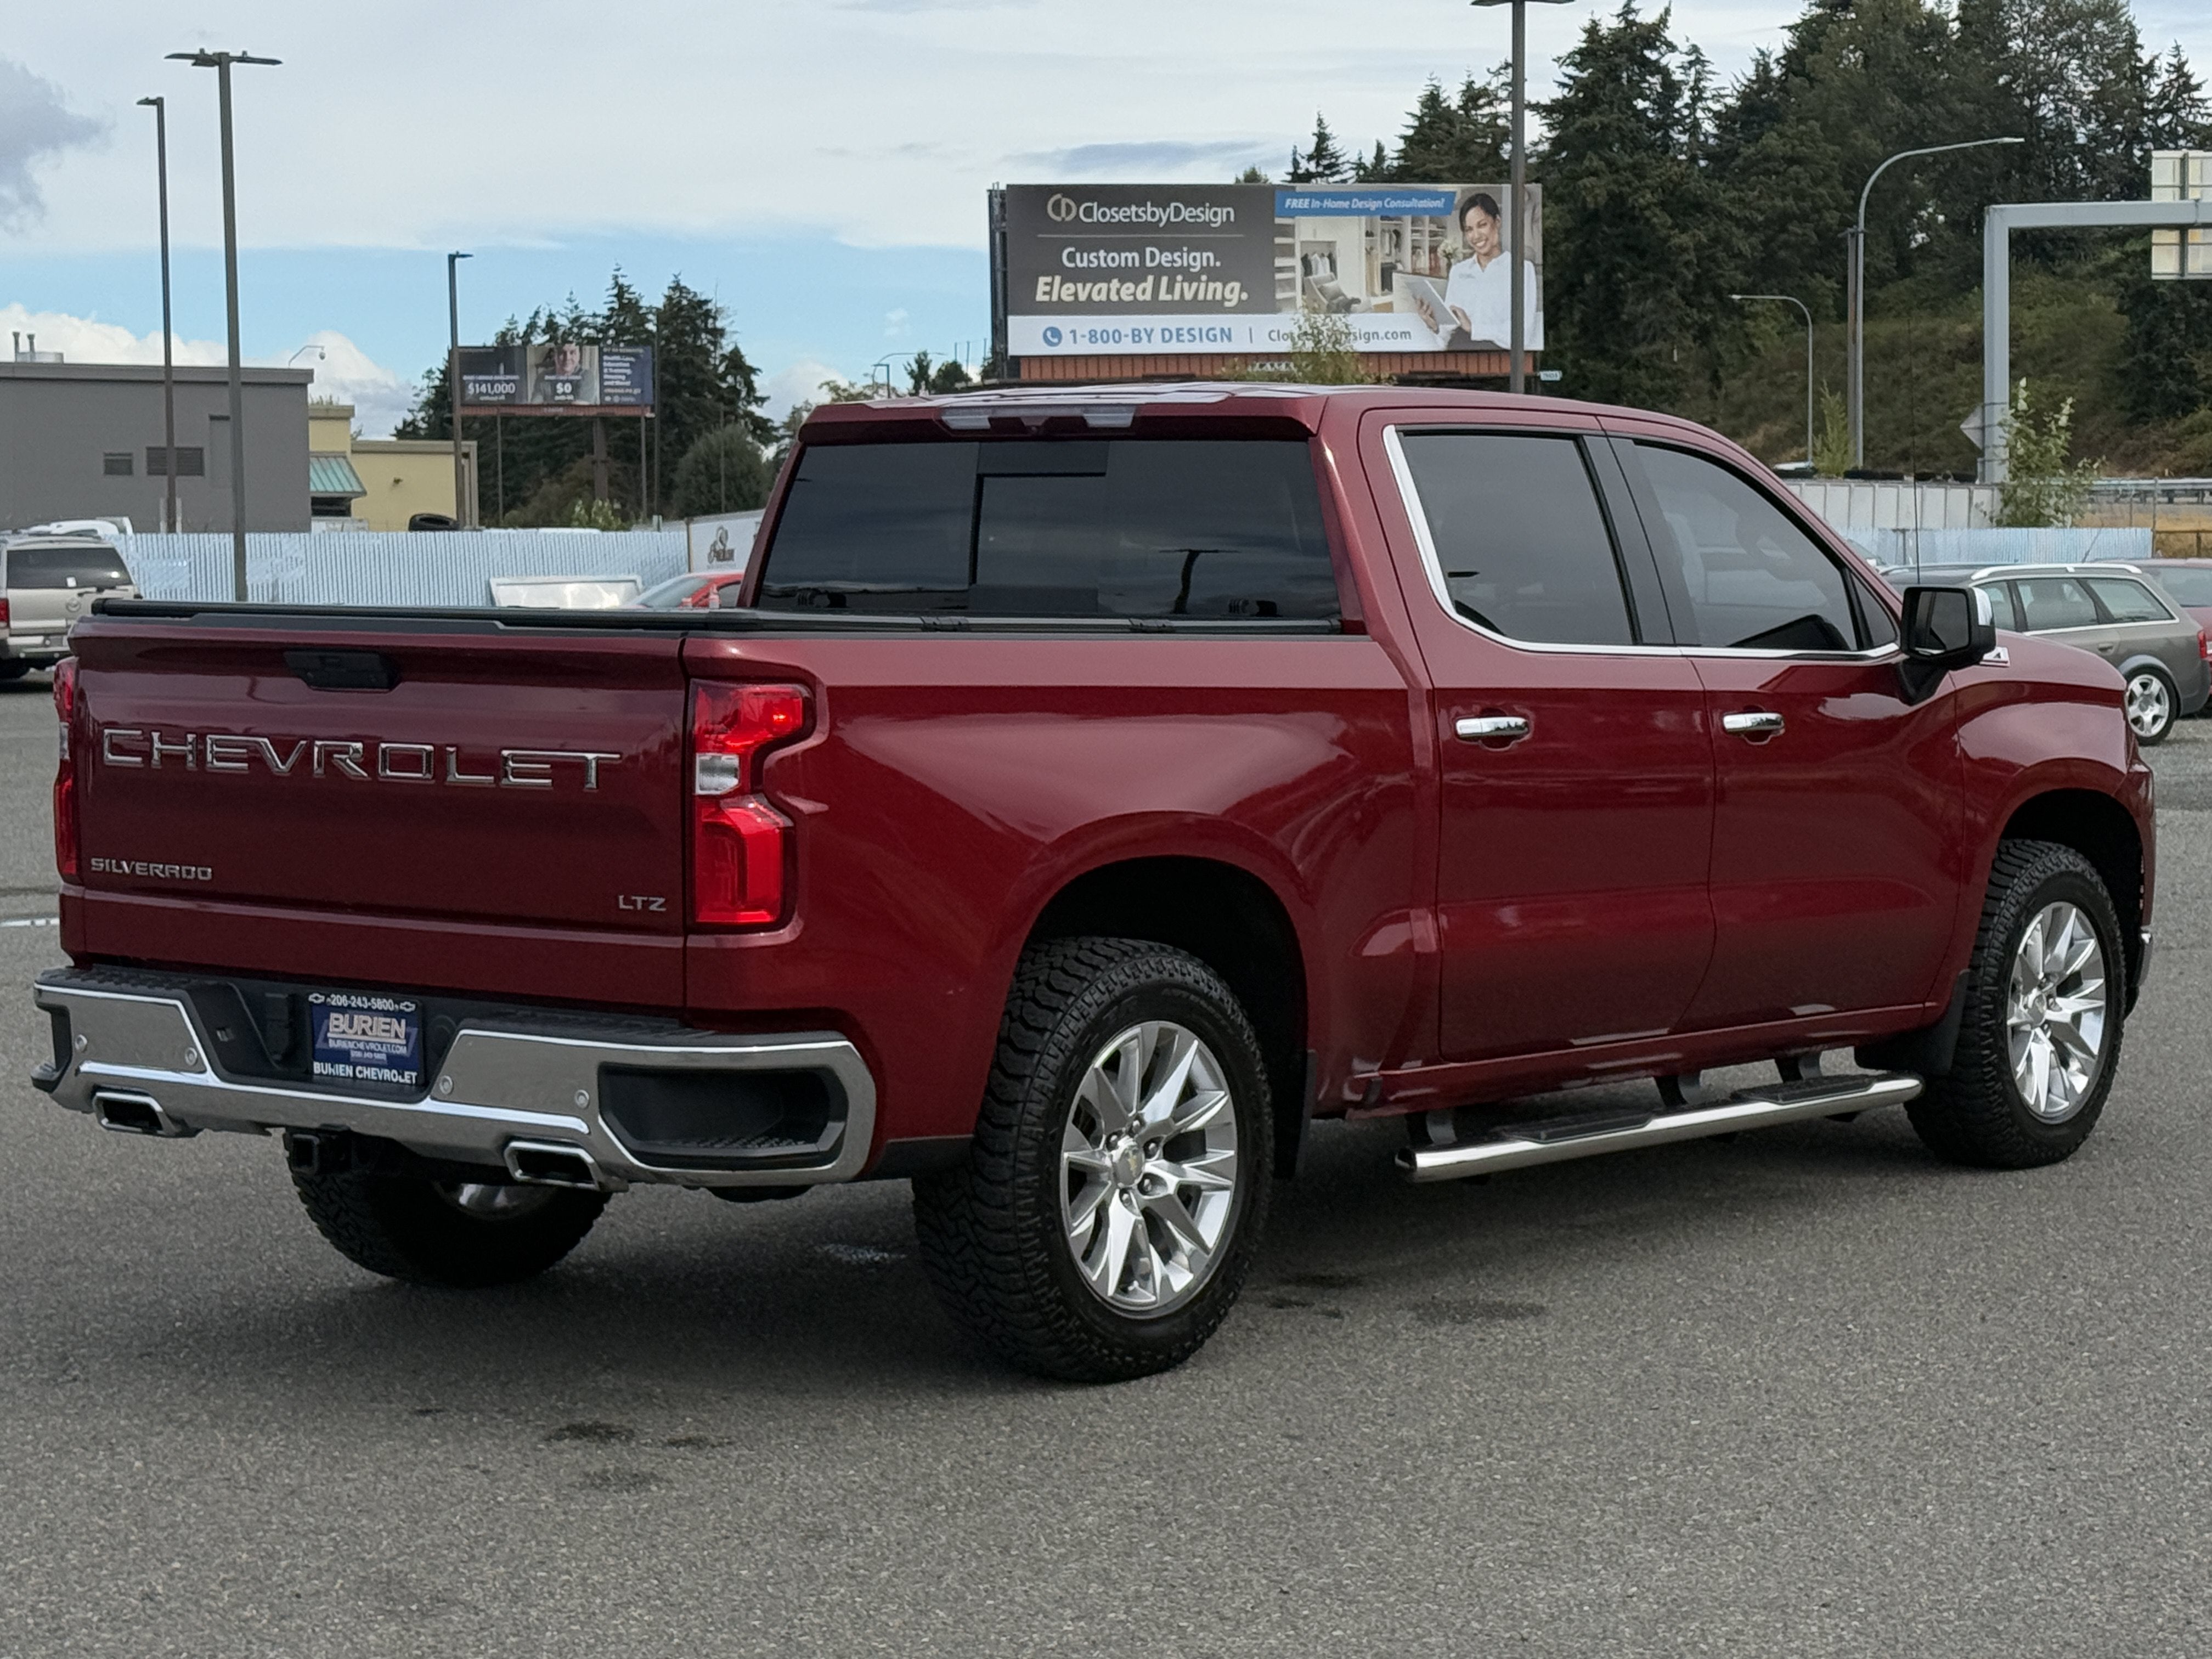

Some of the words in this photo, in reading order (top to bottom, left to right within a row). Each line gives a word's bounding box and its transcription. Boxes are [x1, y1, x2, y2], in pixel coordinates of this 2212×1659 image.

[1284, 198, 1310, 209] FREE
[1351, 198, 1383, 211] Design
[1384, 197, 1446, 209] Consultation!
[1079, 201, 1234, 228] ClosetsbyDesign
[1062, 247, 1140, 268] Custom
[1145, 246, 1222, 273] Design.
[1035, 275, 1154, 302] Elevated
[1158, 274, 1249, 308] Living.
[1069, 328, 1155, 345] 1-800-BY
[1160, 327, 1233, 343] DESIGN
[468, 382, 516, 395] $141,000
[556, 382, 572, 394] $0
[101, 728, 622, 792] CHEVROLET
[91, 857, 213, 881] SILVERADO
[618, 894, 667, 912] LTZ
[330, 994, 394, 1011] 206-243-5800
[330, 1012, 406, 1040] BURIEN
[313, 1061, 353, 1078] BURIEN
